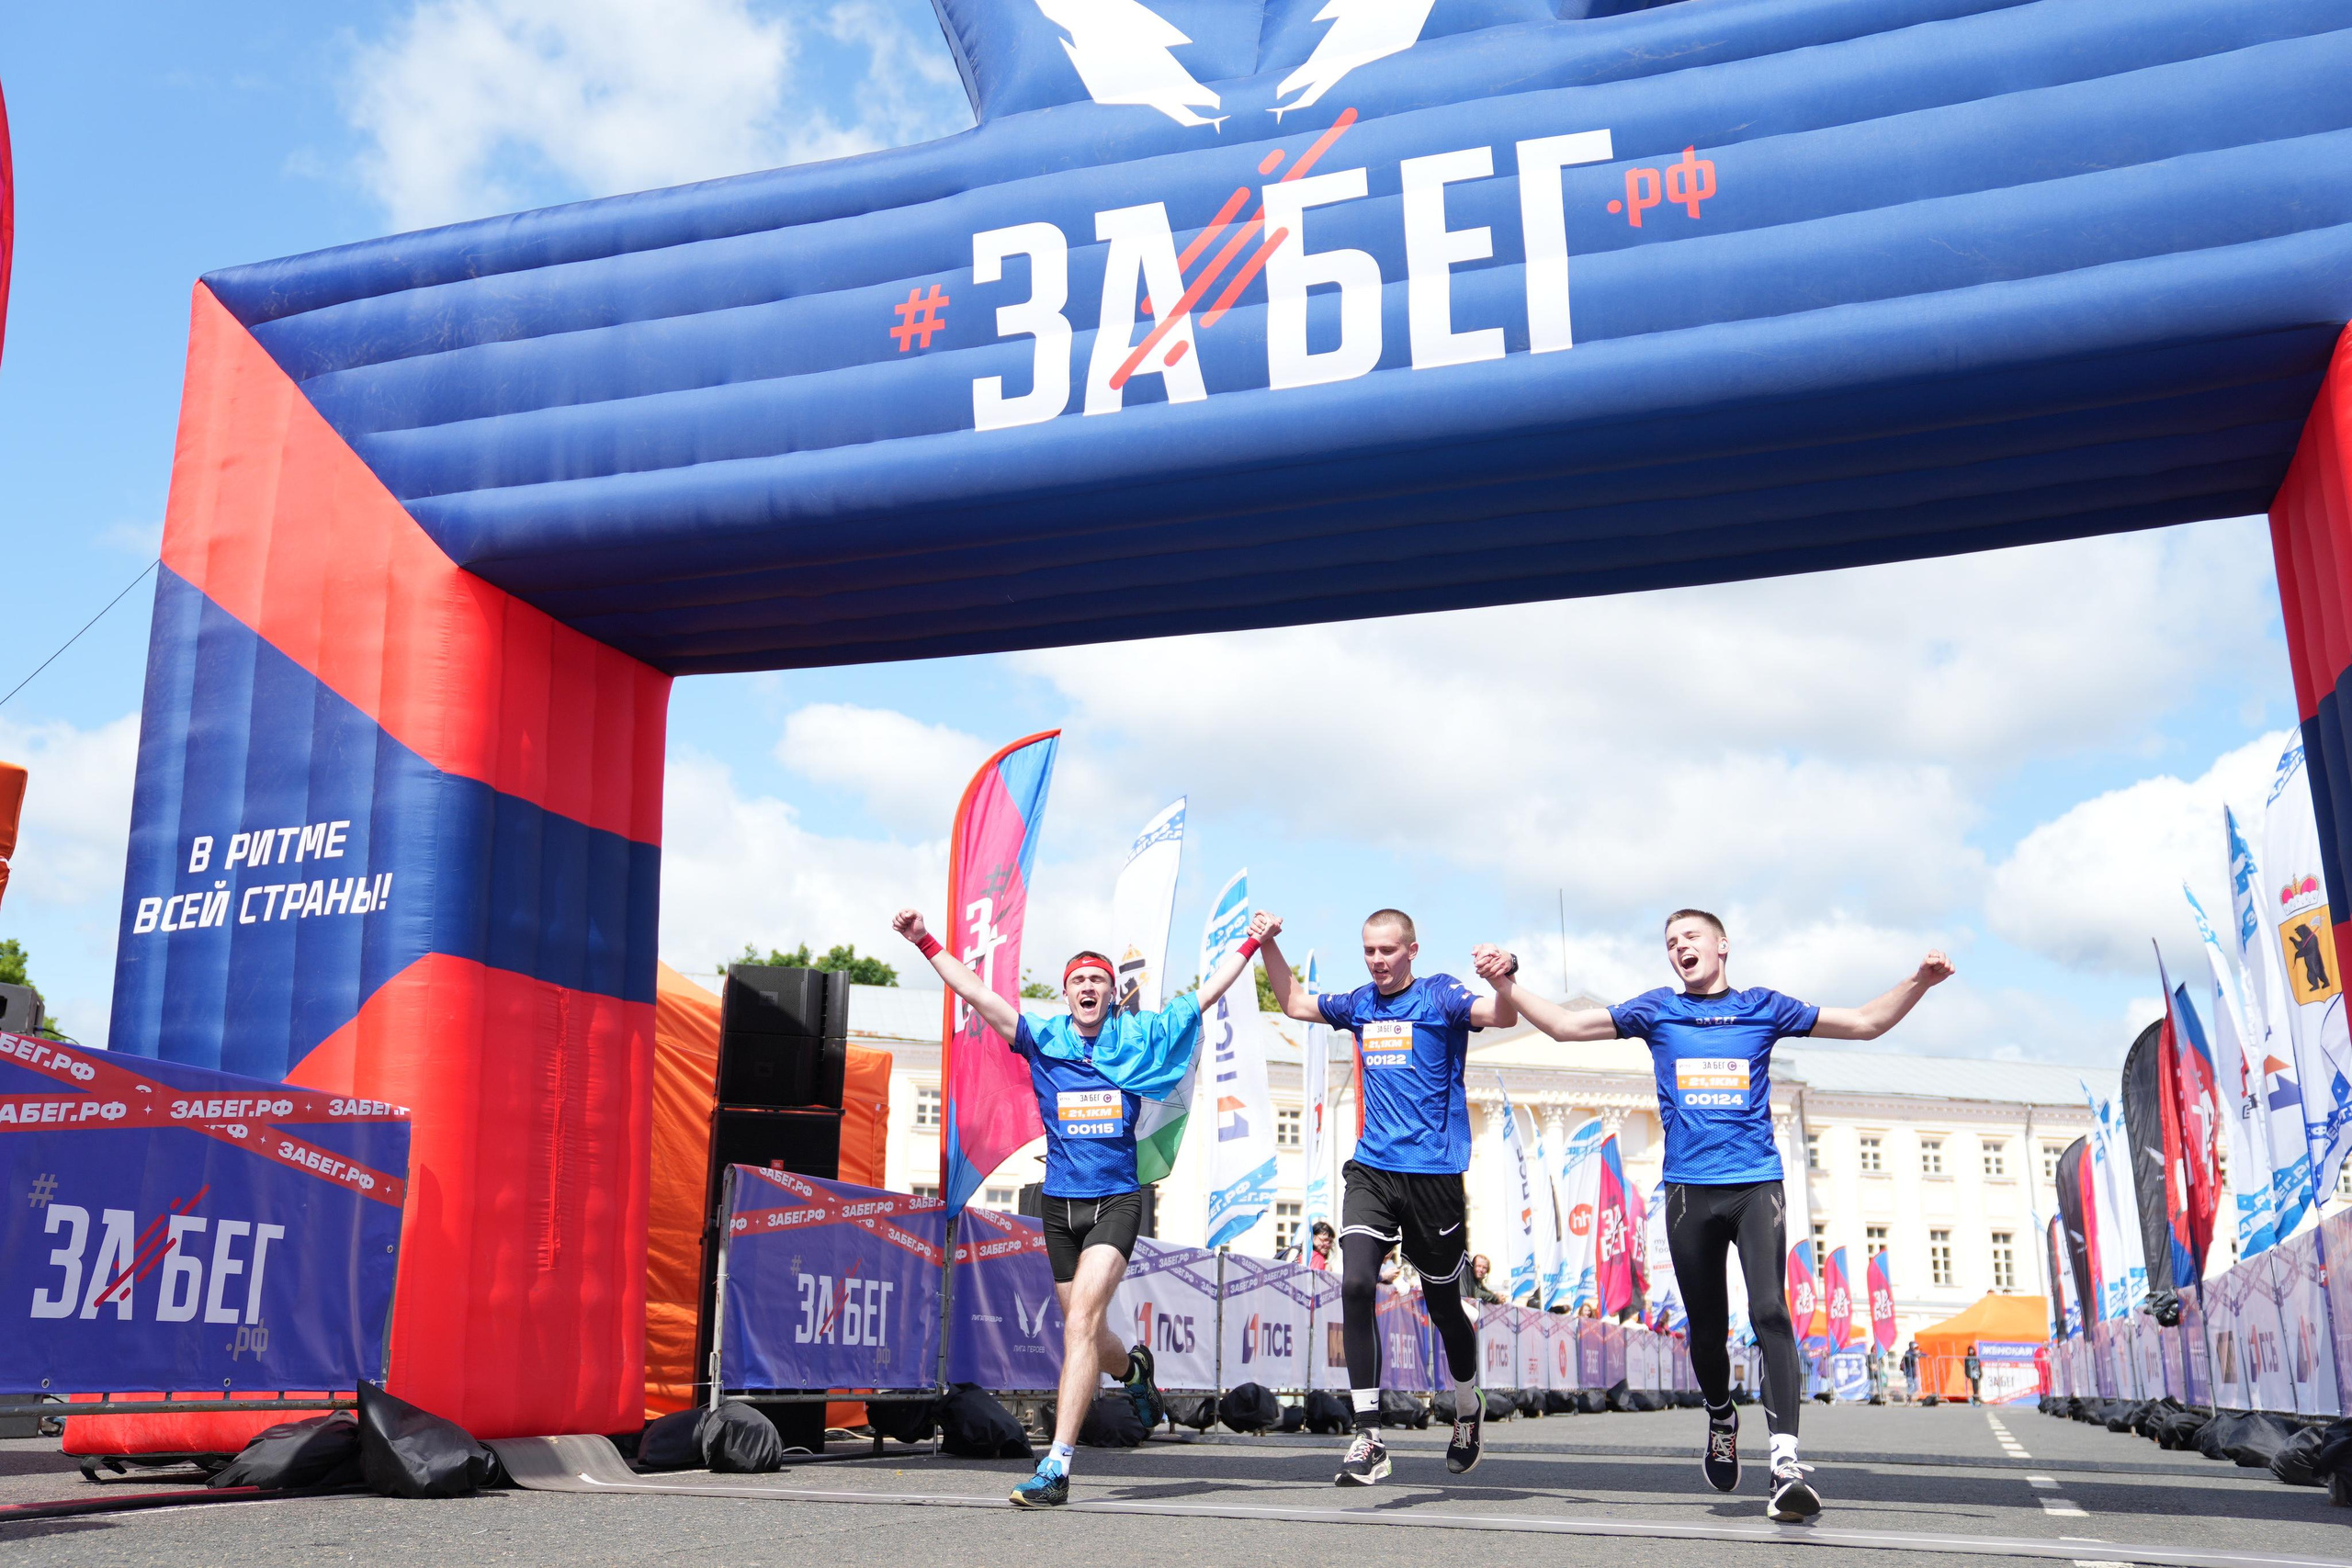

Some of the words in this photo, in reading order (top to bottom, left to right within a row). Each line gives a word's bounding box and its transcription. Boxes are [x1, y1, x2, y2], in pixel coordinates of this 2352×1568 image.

[971, 128, 1614, 433] ЗАБЕГ
[188, 835, 214, 874] В
[224, 820, 351, 870] РИТМЕ
[133, 880, 231, 934] ВСЕЙ
[239, 873, 393, 925] СТРАНЫ!
[1366, 1054, 1407, 1066] 00122
[170, 1099, 294, 1120] ЗАБЕГ.РФ
[1685, 1093, 1744, 1106] 00124
[1067, 1122, 1115, 1135] 00115
[277, 1142, 375, 1190] ЗАБЕГ.РФ
[767, 1209, 826, 1227] ЗАБЕГ.РФ
[842, 1201, 895, 1219] ЗАБЕГ.РФ
[1573, 1212, 1592, 1230] hh
[888, 1228, 933, 1258] ЗАБЕГ.РФ
[979, 1240, 1022, 1256] ЗАБЕГ.РФ
[30, 1203, 286, 1325] ЗАБЕГ
[1159, 1253, 1190, 1268] ЗАБЕГ.РФ
[1230, 1278, 1259, 1293] ЗАБЕГ.РФ
[796, 1273, 894, 1347] ЗАБЕГ
[1158, 1313, 1195, 1353] ПСБ
[1262, 1322, 1294, 1357] ПСБ
[1013, 1345, 1026, 1353] ЛИГА
[1027, 1346, 1046, 1354] ГЕРОЕВ
[1982, 1346, 2033, 1357] ЖЕНСКАЯ
